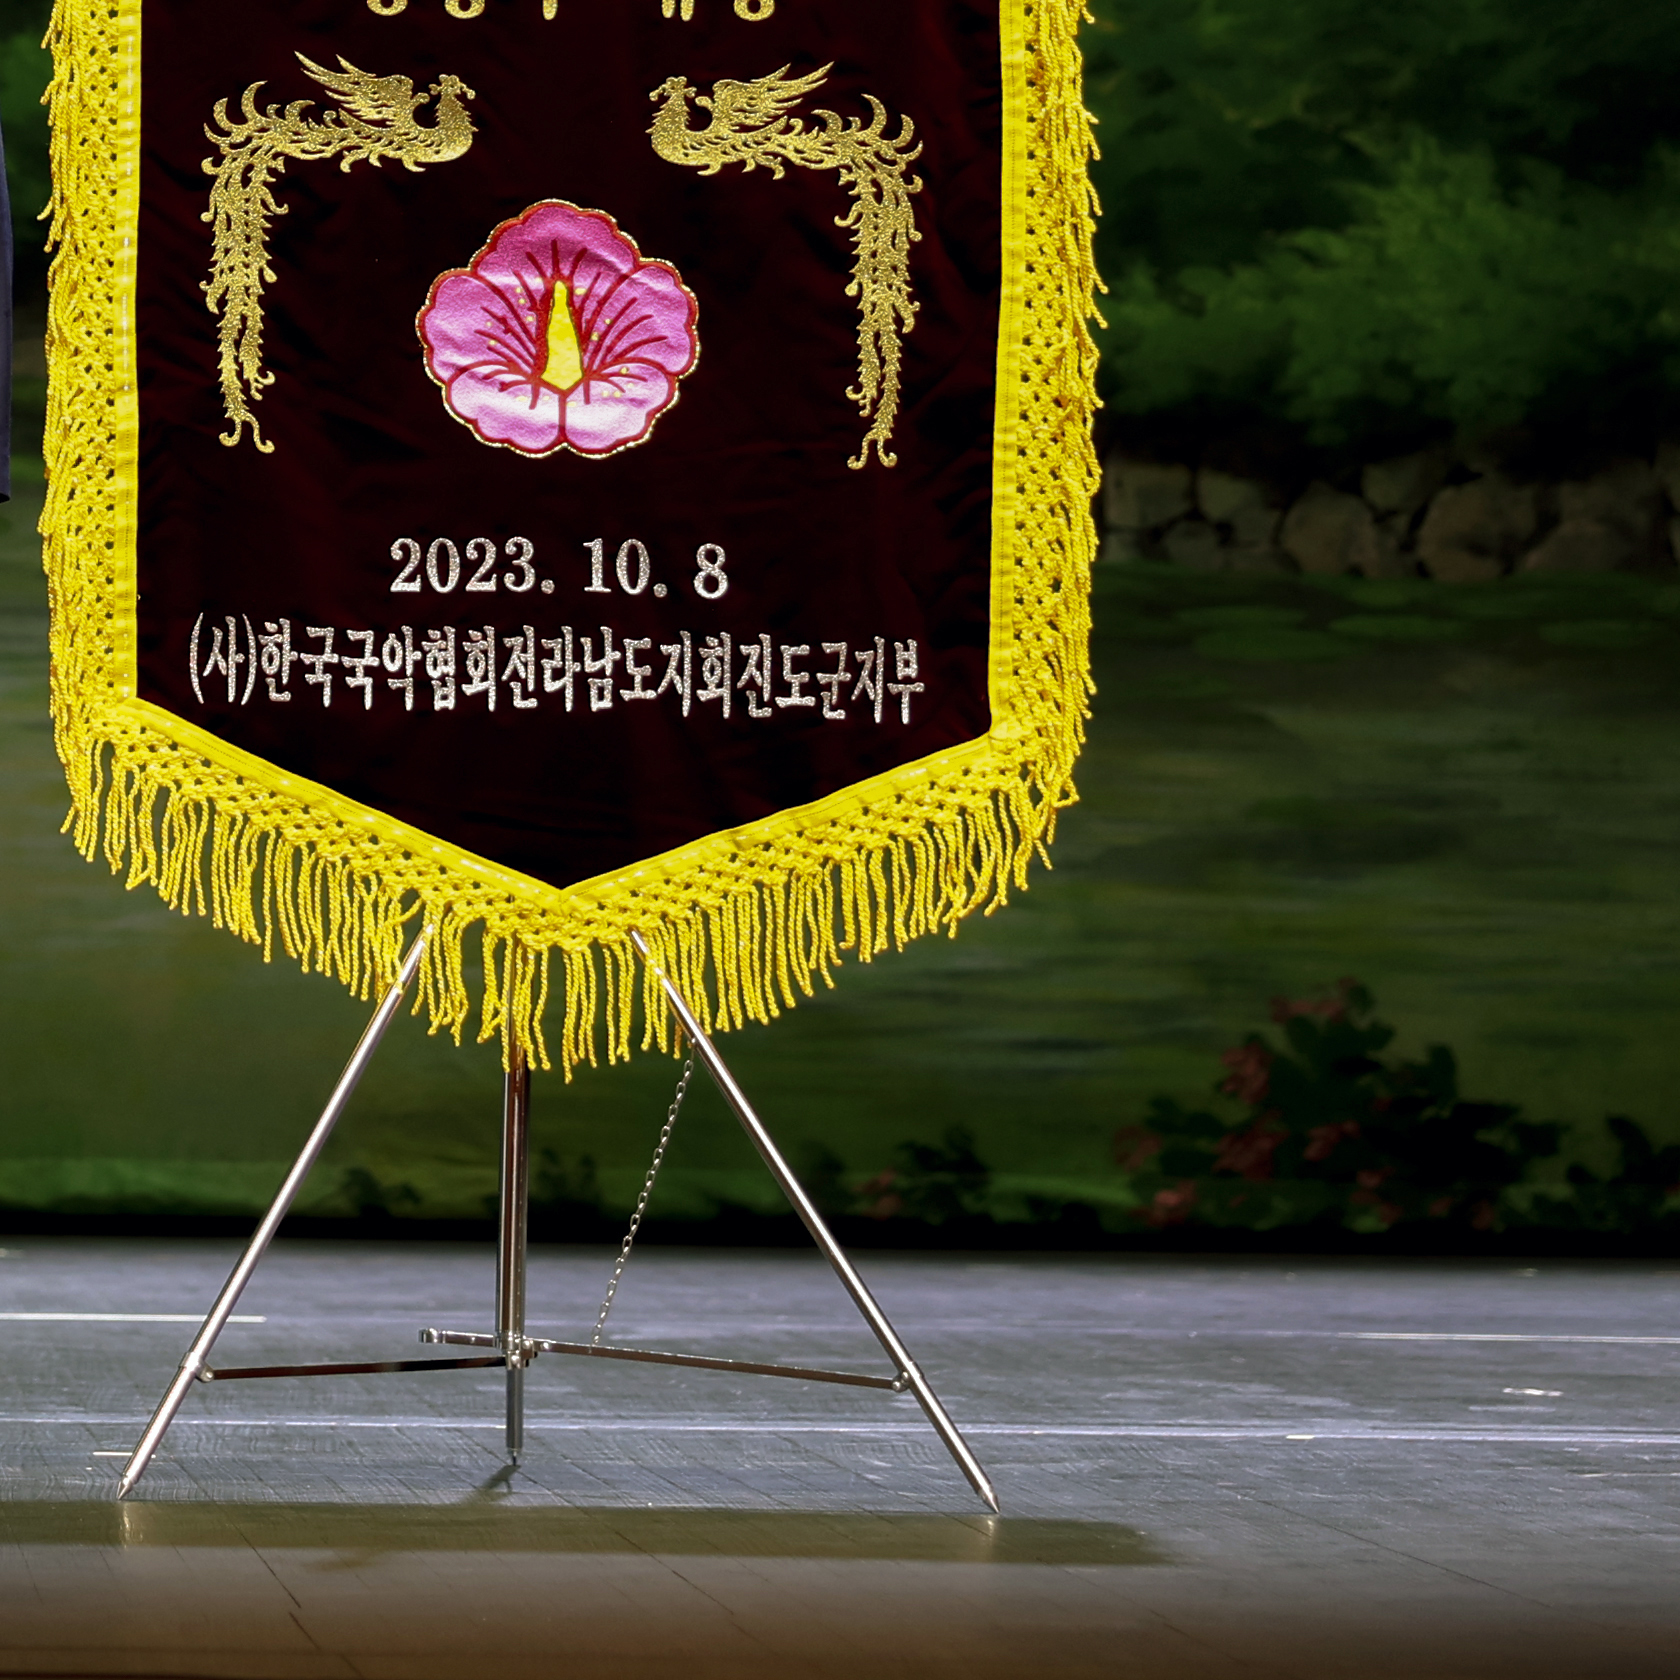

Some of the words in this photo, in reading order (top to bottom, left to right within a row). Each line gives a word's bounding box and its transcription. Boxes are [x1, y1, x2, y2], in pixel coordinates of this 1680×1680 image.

[389, 536, 555, 595] 2023.
[582, 537, 668, 598] 10.
[693, 542, 729, 600] 8
[189, 612, 925, 725] (사)한국국악협회전라남도지회진도군지부
